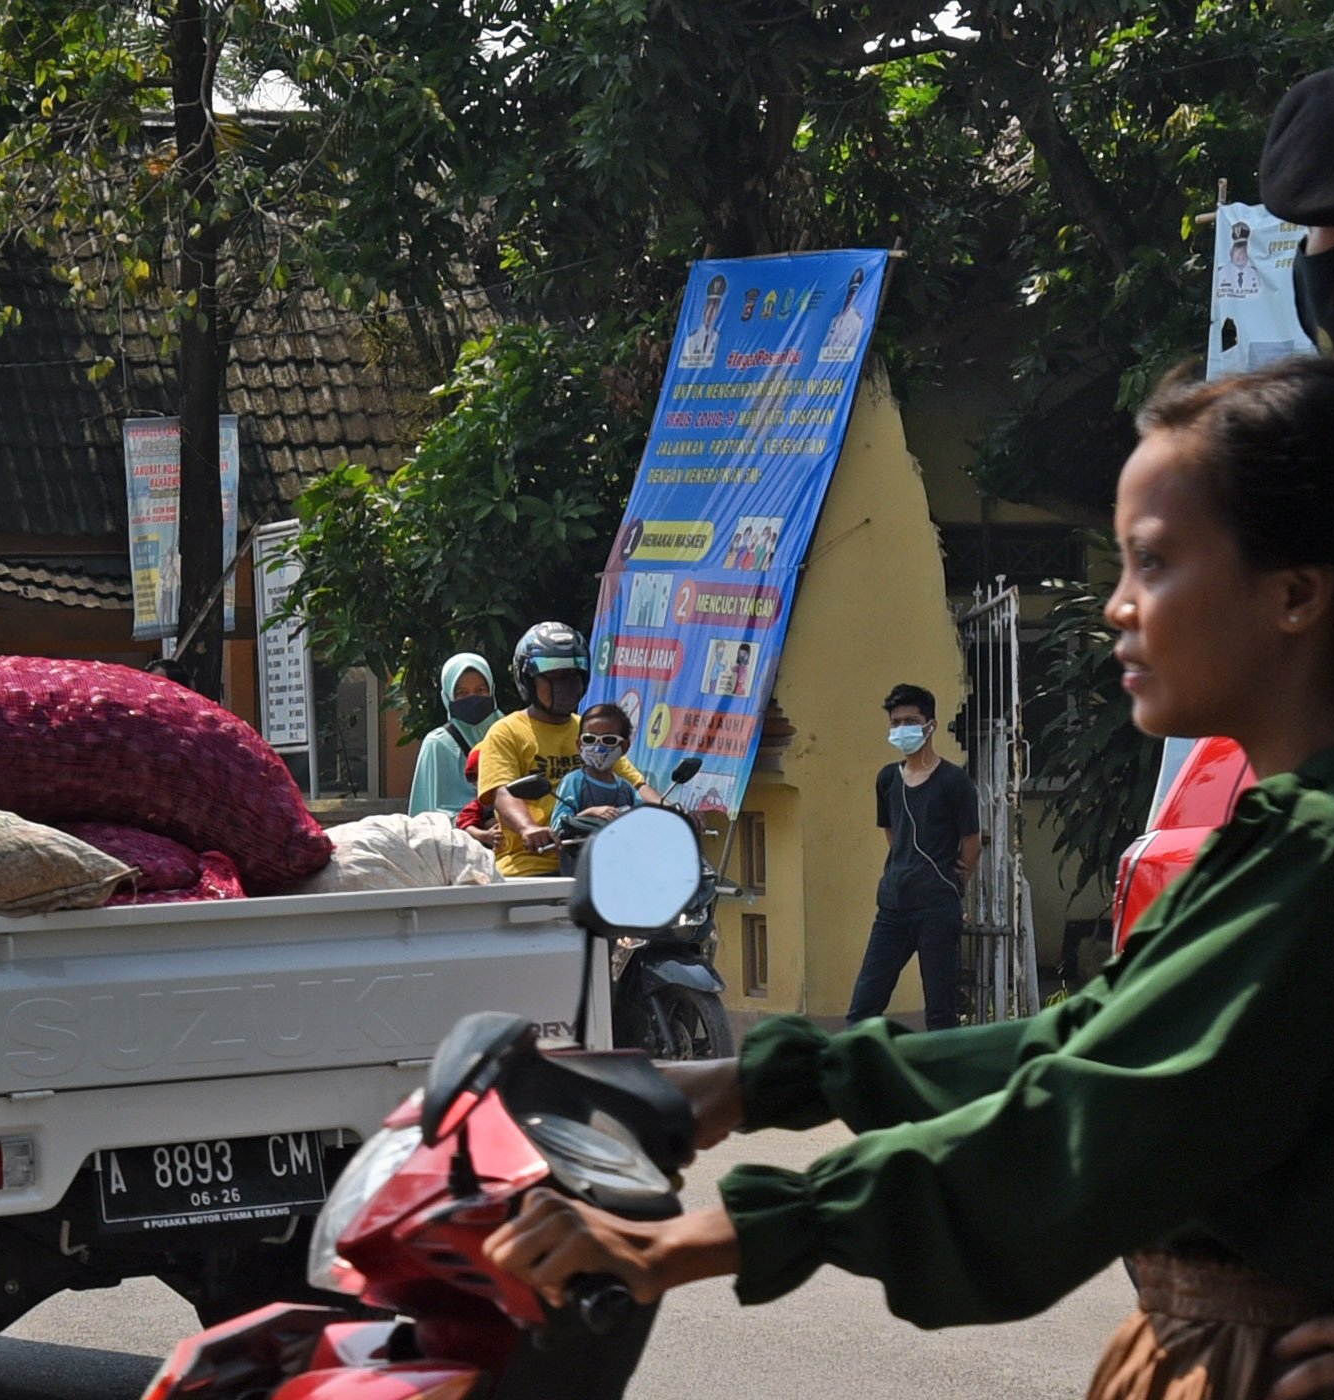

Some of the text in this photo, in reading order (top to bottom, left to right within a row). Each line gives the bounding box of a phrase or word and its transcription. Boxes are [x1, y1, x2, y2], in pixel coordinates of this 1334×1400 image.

[623, 526, 638, 554] 1
[675, 533, 707, 549] MASKER
[677, 587, 690, 617] 2
[696, 593, 776, 618] MENCUCI TANGAN
[598, 641, 610, 671] 3
[613, 646, 677, 671] MENJAGA JARAK
[651, 711, 664, 741] 4
[683, 712, 744, 731] MENJAUHI
[547, 754, 584, 768] THRE
[6, 972, 435, 1079] SUZUKI
[531, 1020, 577, 1039] RRY
[110, 1131, 313, 1195] A 8893 CM
[151, 1217, 188, 1229] PUSAKA
[189, 1214, 221, 1226] MOTOR
[222, 1210, 253, 1222] UTAMA
[254, 1206, 290, 1218] SERANG
